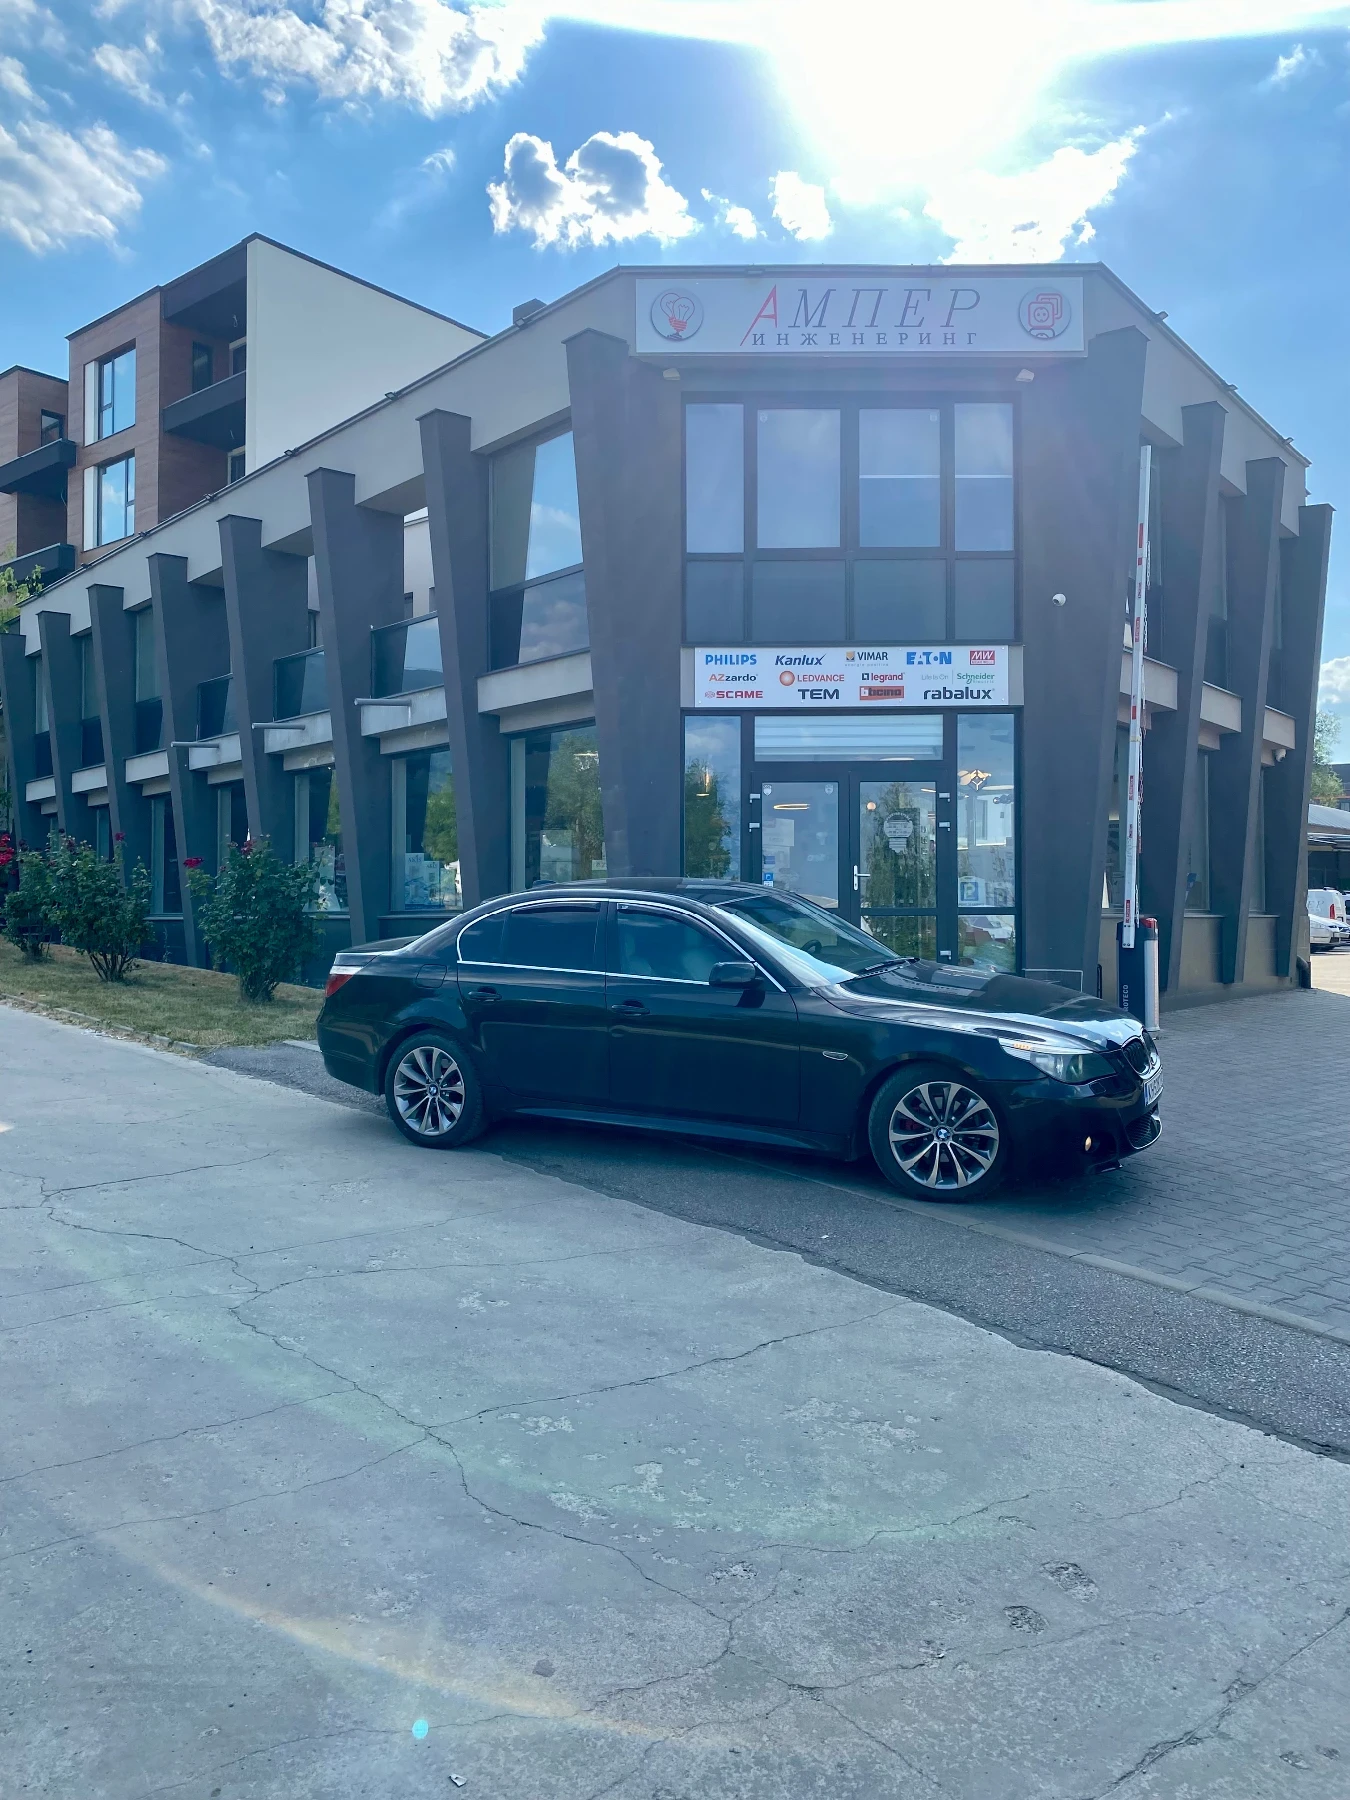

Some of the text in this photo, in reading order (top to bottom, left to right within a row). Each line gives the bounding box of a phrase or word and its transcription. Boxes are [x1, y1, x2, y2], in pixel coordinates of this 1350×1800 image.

[740, 284, 981, 346] АМПЕР
[753, 332, 977, 346] ИНЖЕНЕРИНГ
[705, 654, 757, 666] PHILIPS
[774, 653, 827, 666] Kanlux
[857, 651, 888, 661] VIMAR
[906, 651, 952, 665] EATON
[797, 674, 845, 682] LEDVANCE
[871, 672, 904, 683] legrand
[956, 672, 995, 684] Schneider
[716, 690, 764, 699] SCAME
[797, 688, 840, 700] TEM
[923, 686, 993, 700] rabalux
